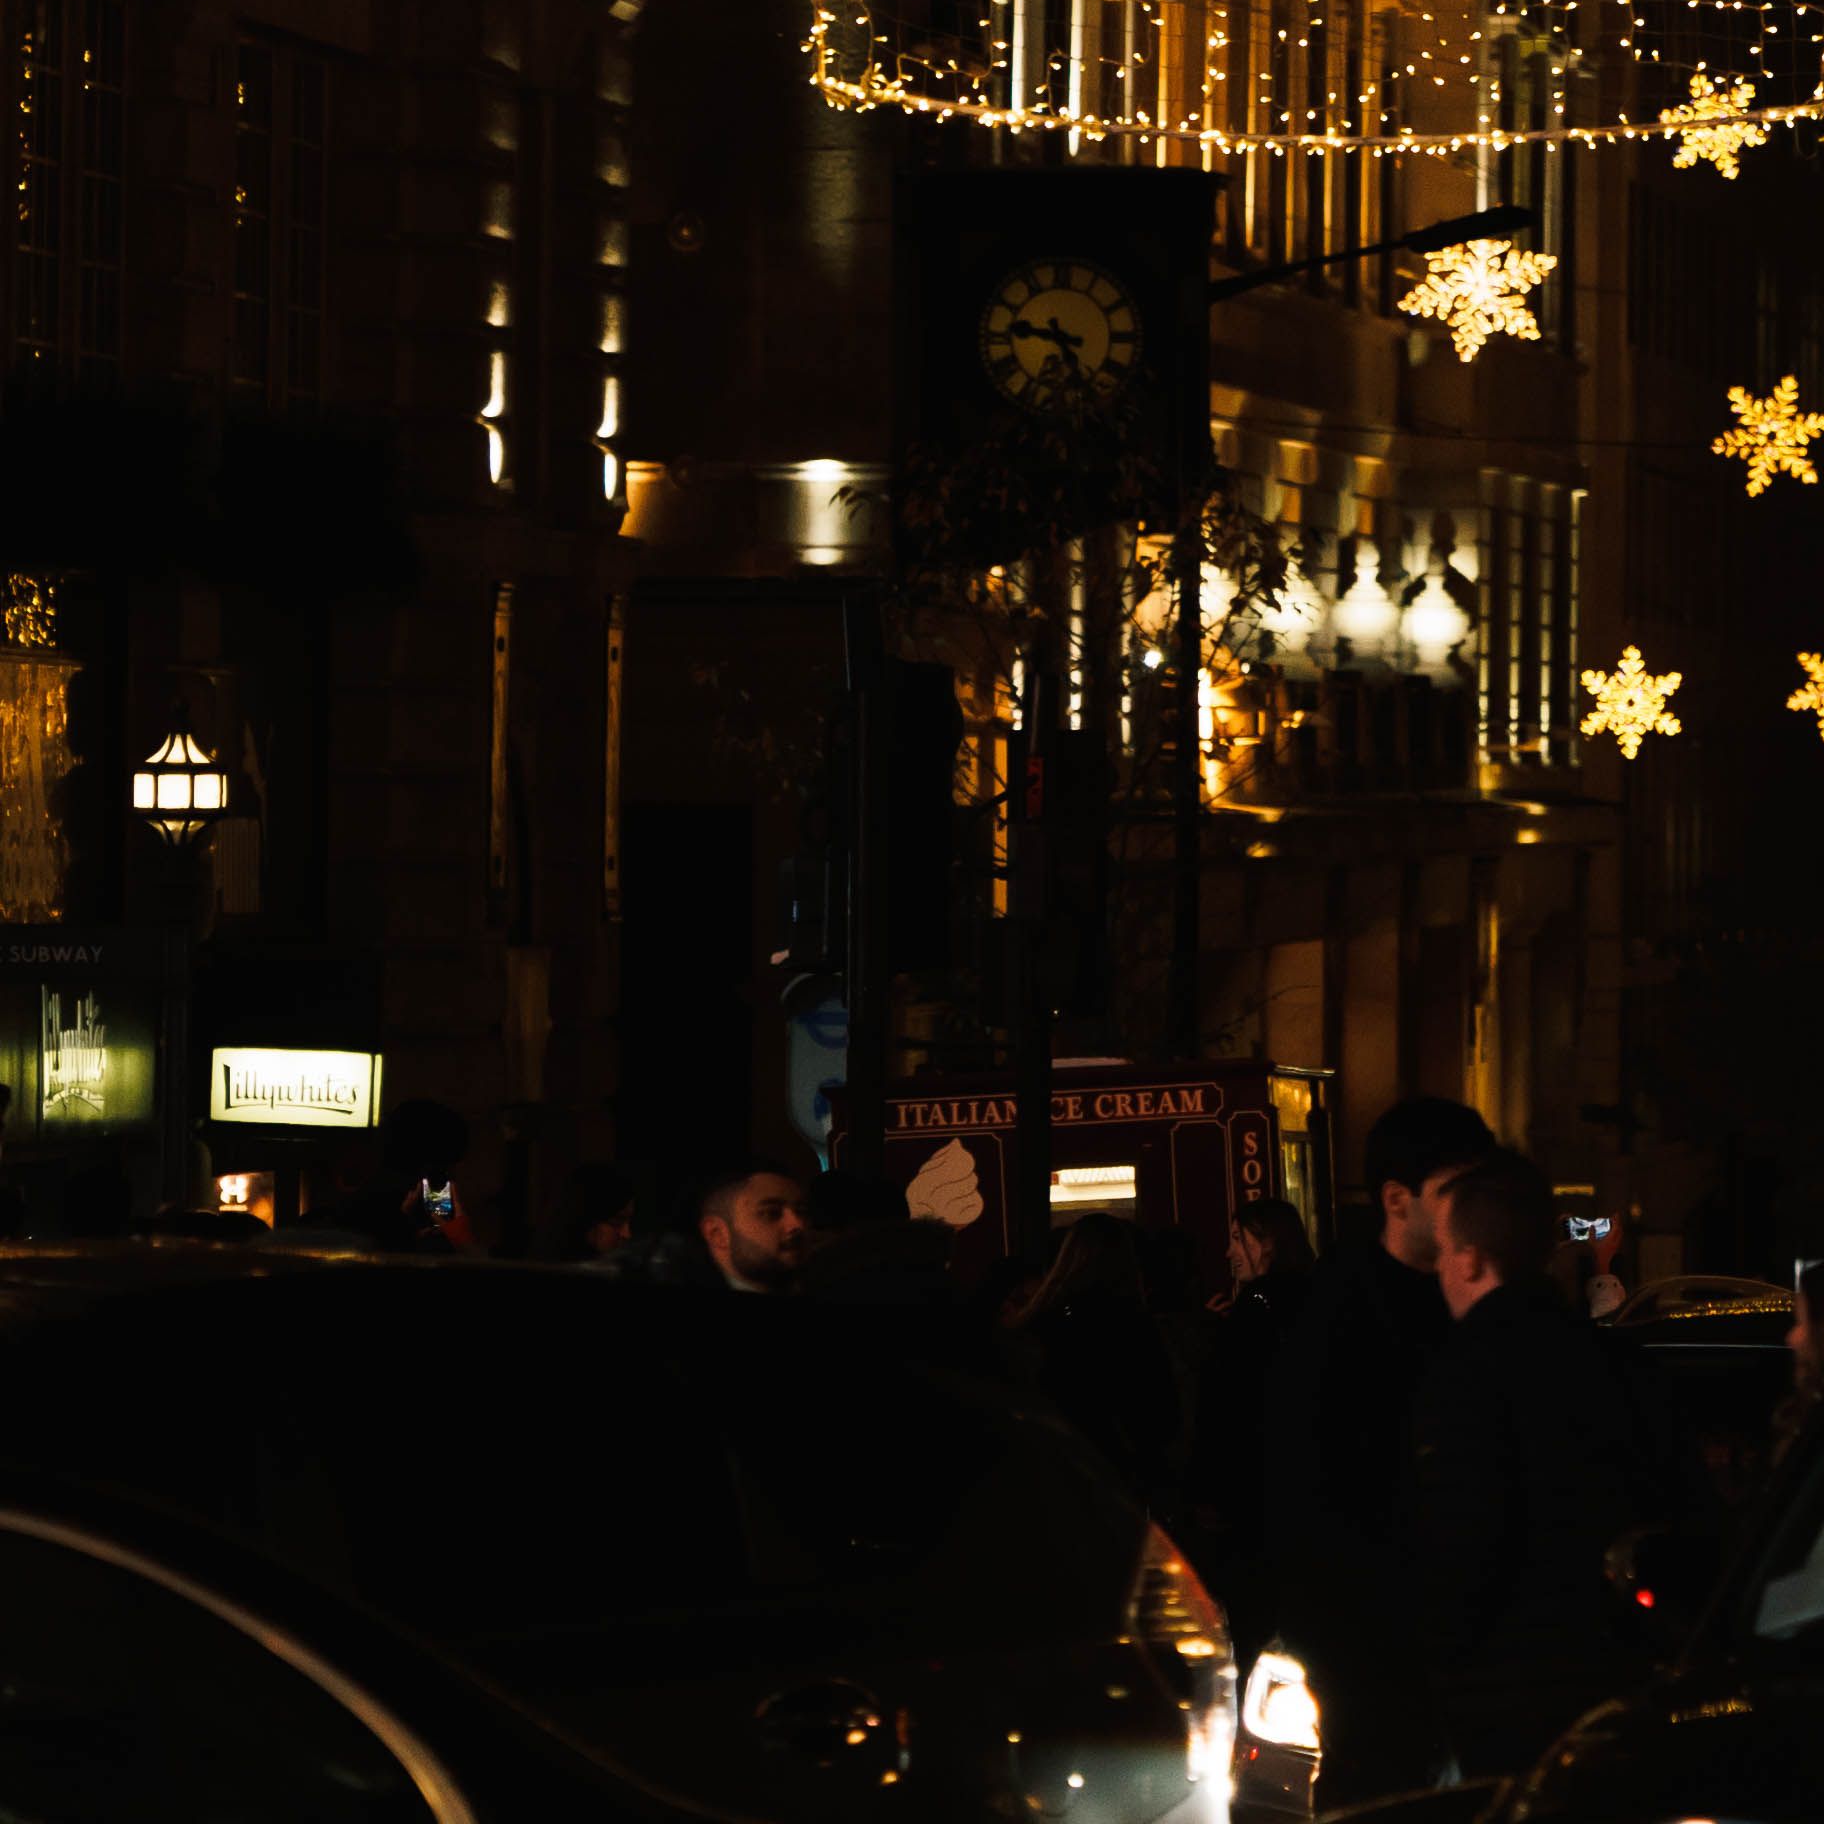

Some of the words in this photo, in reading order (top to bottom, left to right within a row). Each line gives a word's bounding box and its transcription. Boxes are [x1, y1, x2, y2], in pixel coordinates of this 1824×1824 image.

[8, 945, 103, 963] SUBWAY
[223, 1064, 359, 1114] Lillywhites
[1051, 1094, 1084, 1122] CE
[1094, 1088, 1204, 1119] CREAM
